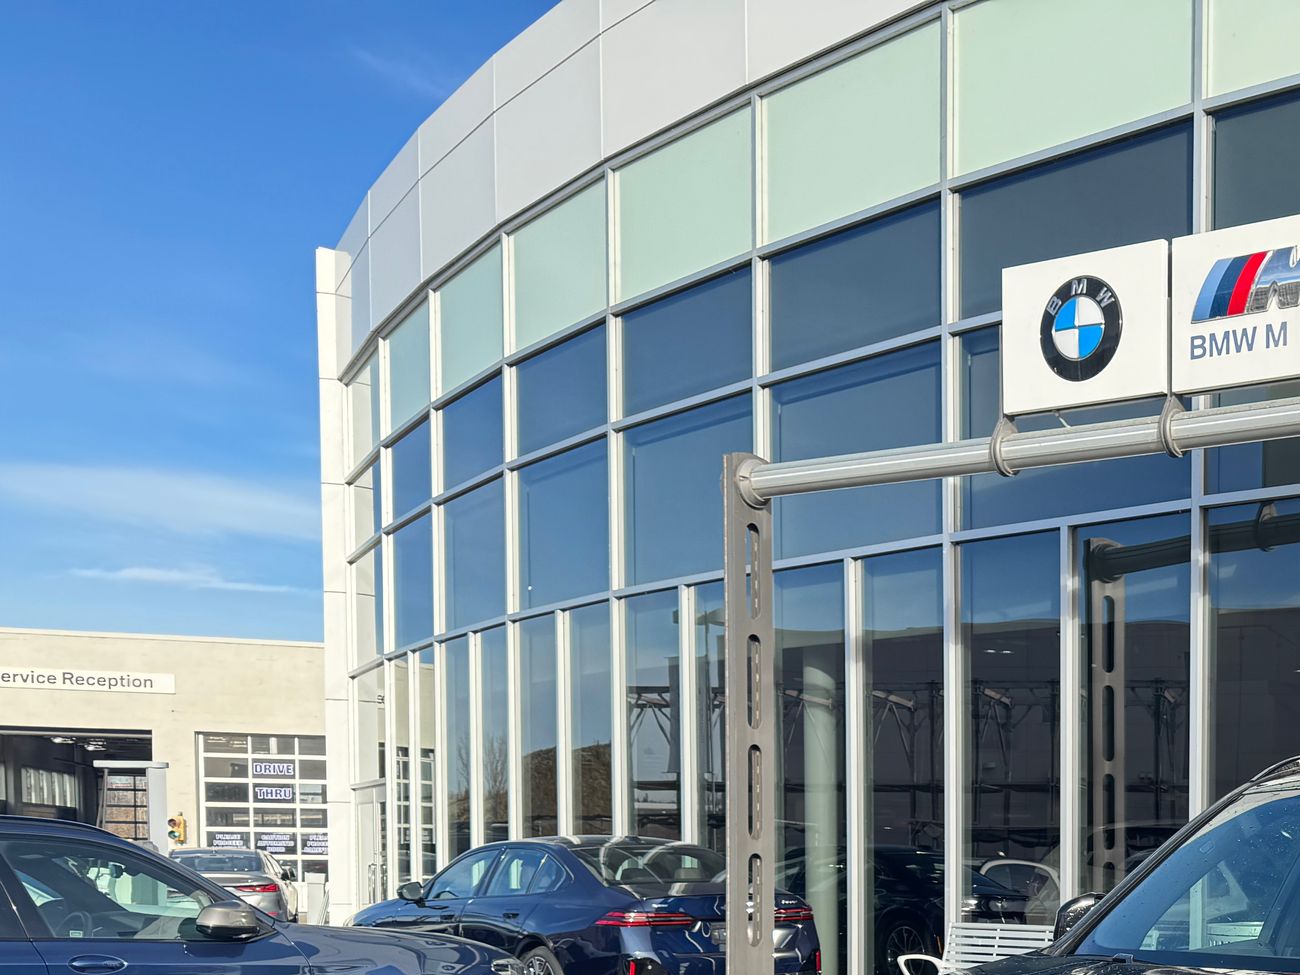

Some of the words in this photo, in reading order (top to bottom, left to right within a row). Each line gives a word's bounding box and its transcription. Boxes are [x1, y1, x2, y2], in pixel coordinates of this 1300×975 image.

[1046, 278, 1115, 316] BMW
[1190, 326, 1257, 360] BMW
[1265, 321, 1288, 348] M
[1, 670, 57, 684] ervice
[62, 671, 154, 689] Reception
[254, 763, 293, 775] DRIVE
[255, 787, 292, 799] THRU
